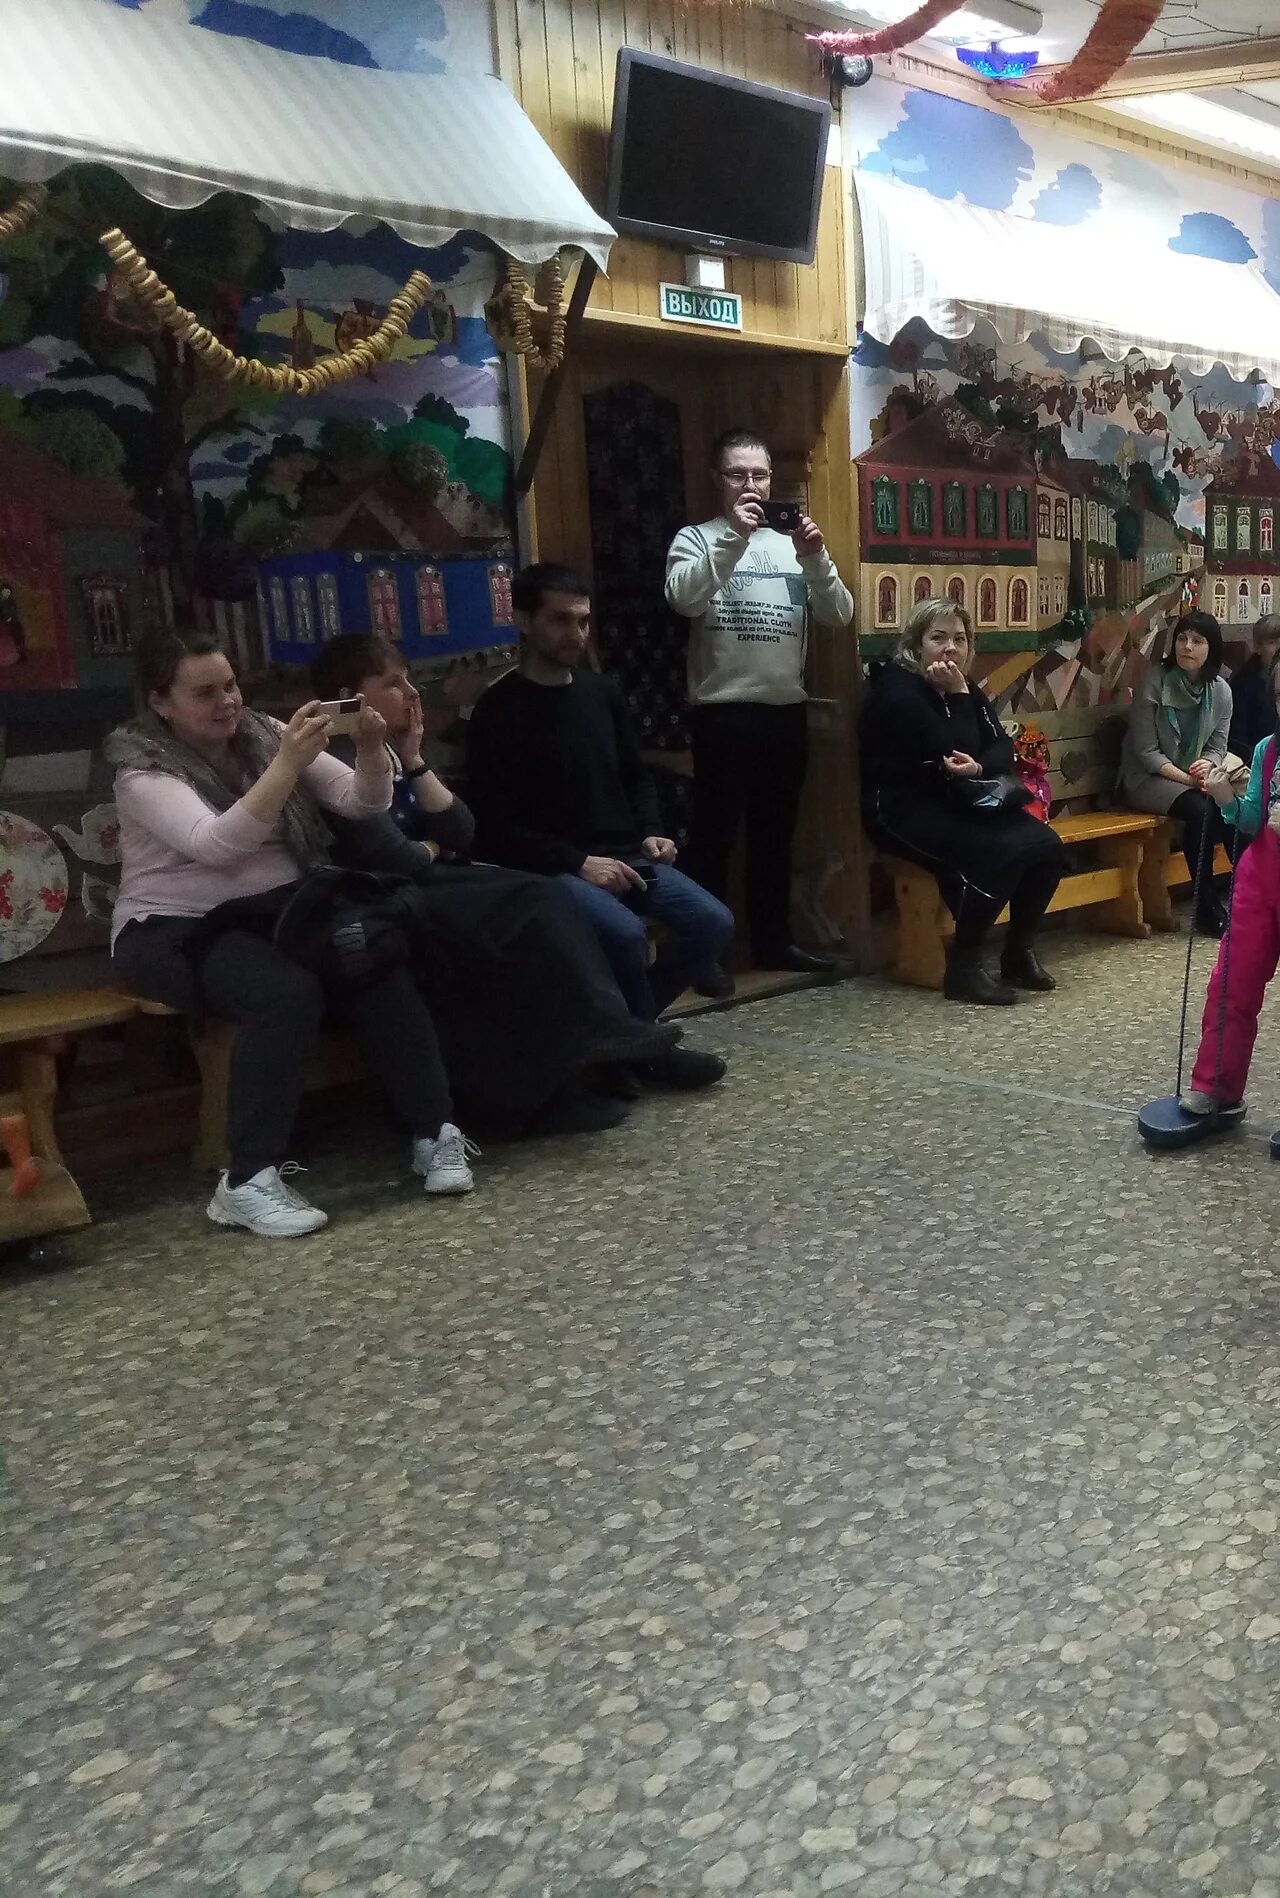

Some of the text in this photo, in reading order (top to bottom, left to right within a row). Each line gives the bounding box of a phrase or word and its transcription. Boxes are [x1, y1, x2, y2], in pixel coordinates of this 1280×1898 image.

[669, 292, 735, 323] ВЫХОД
[716, 616, 792, 628] TRADITIONAL CLOTH
[737, 634, 780, 643] EXPERIENCE
